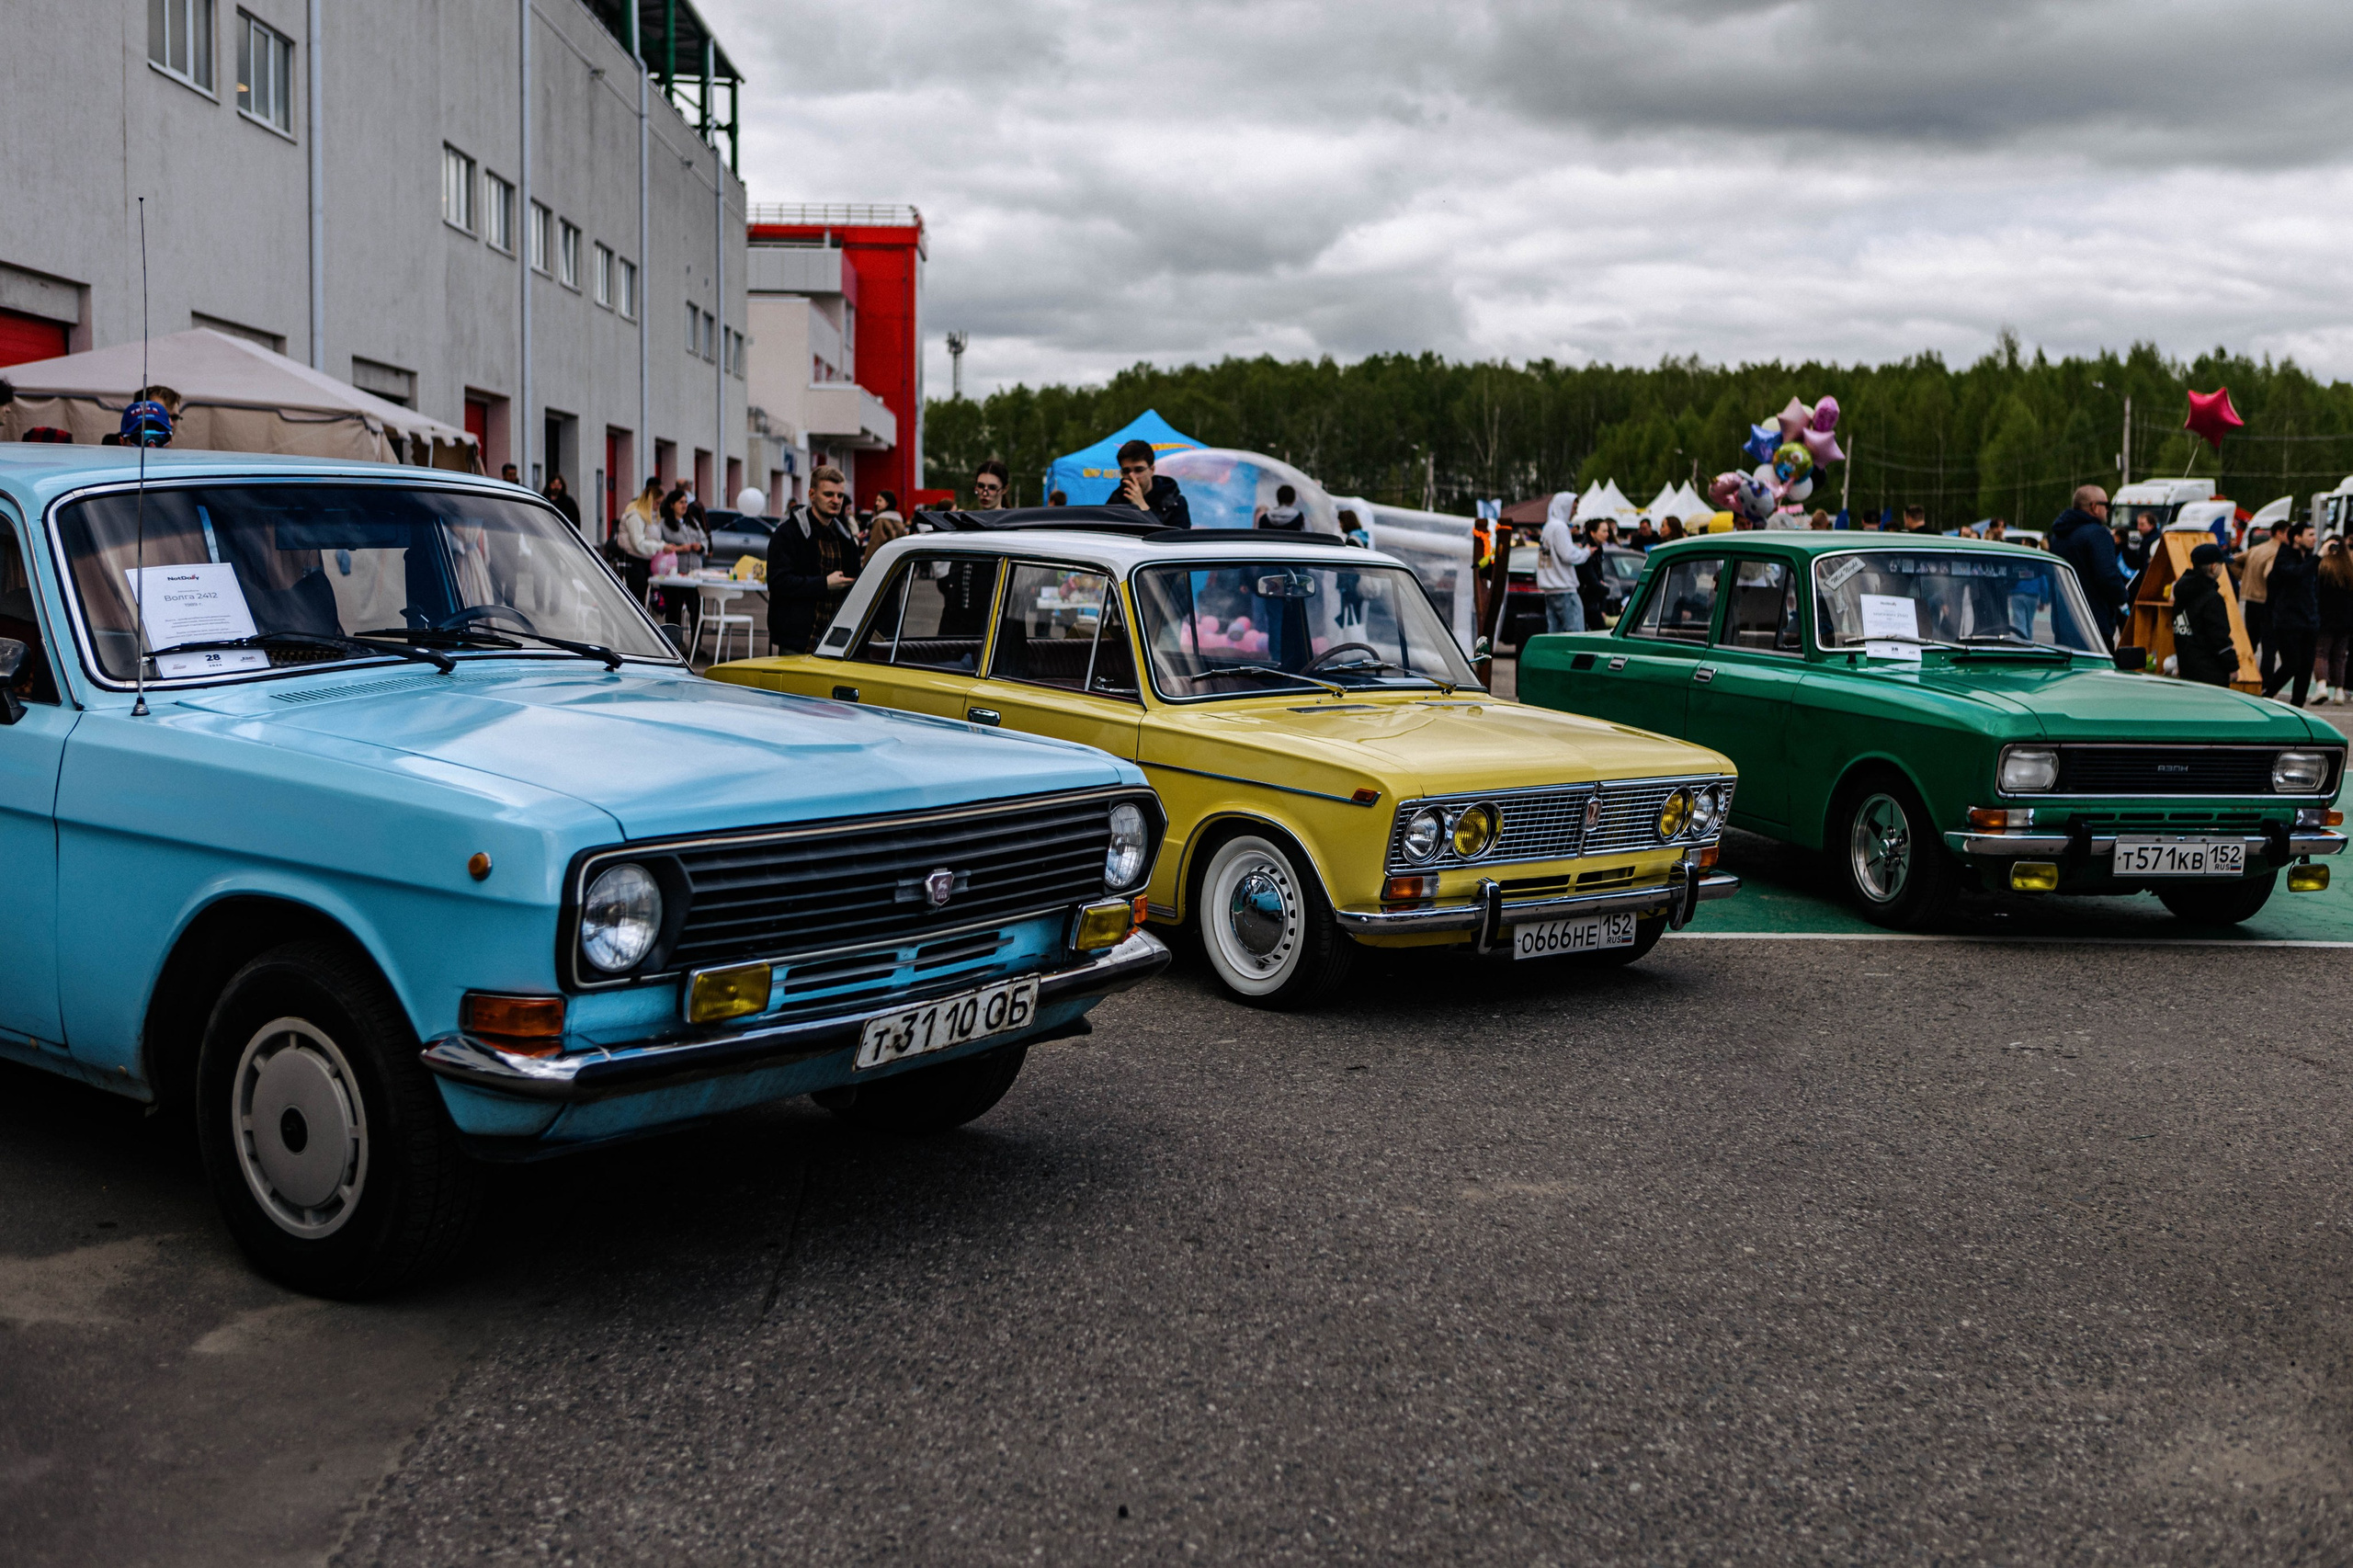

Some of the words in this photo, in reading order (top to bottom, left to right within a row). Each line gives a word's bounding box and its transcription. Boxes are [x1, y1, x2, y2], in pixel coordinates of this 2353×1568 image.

[164, 594, 195, 602] Волга
[205, 653, 221, 662] 28
[2122, 846, 2204, 870] Т571КВ
[2210, 846, 2240, 863] 152
[1521, 921, 1598, 954] О666НЕ
[1602, 913, 1631, 937] 152
[1606, 935, 1621, 944] RUS
